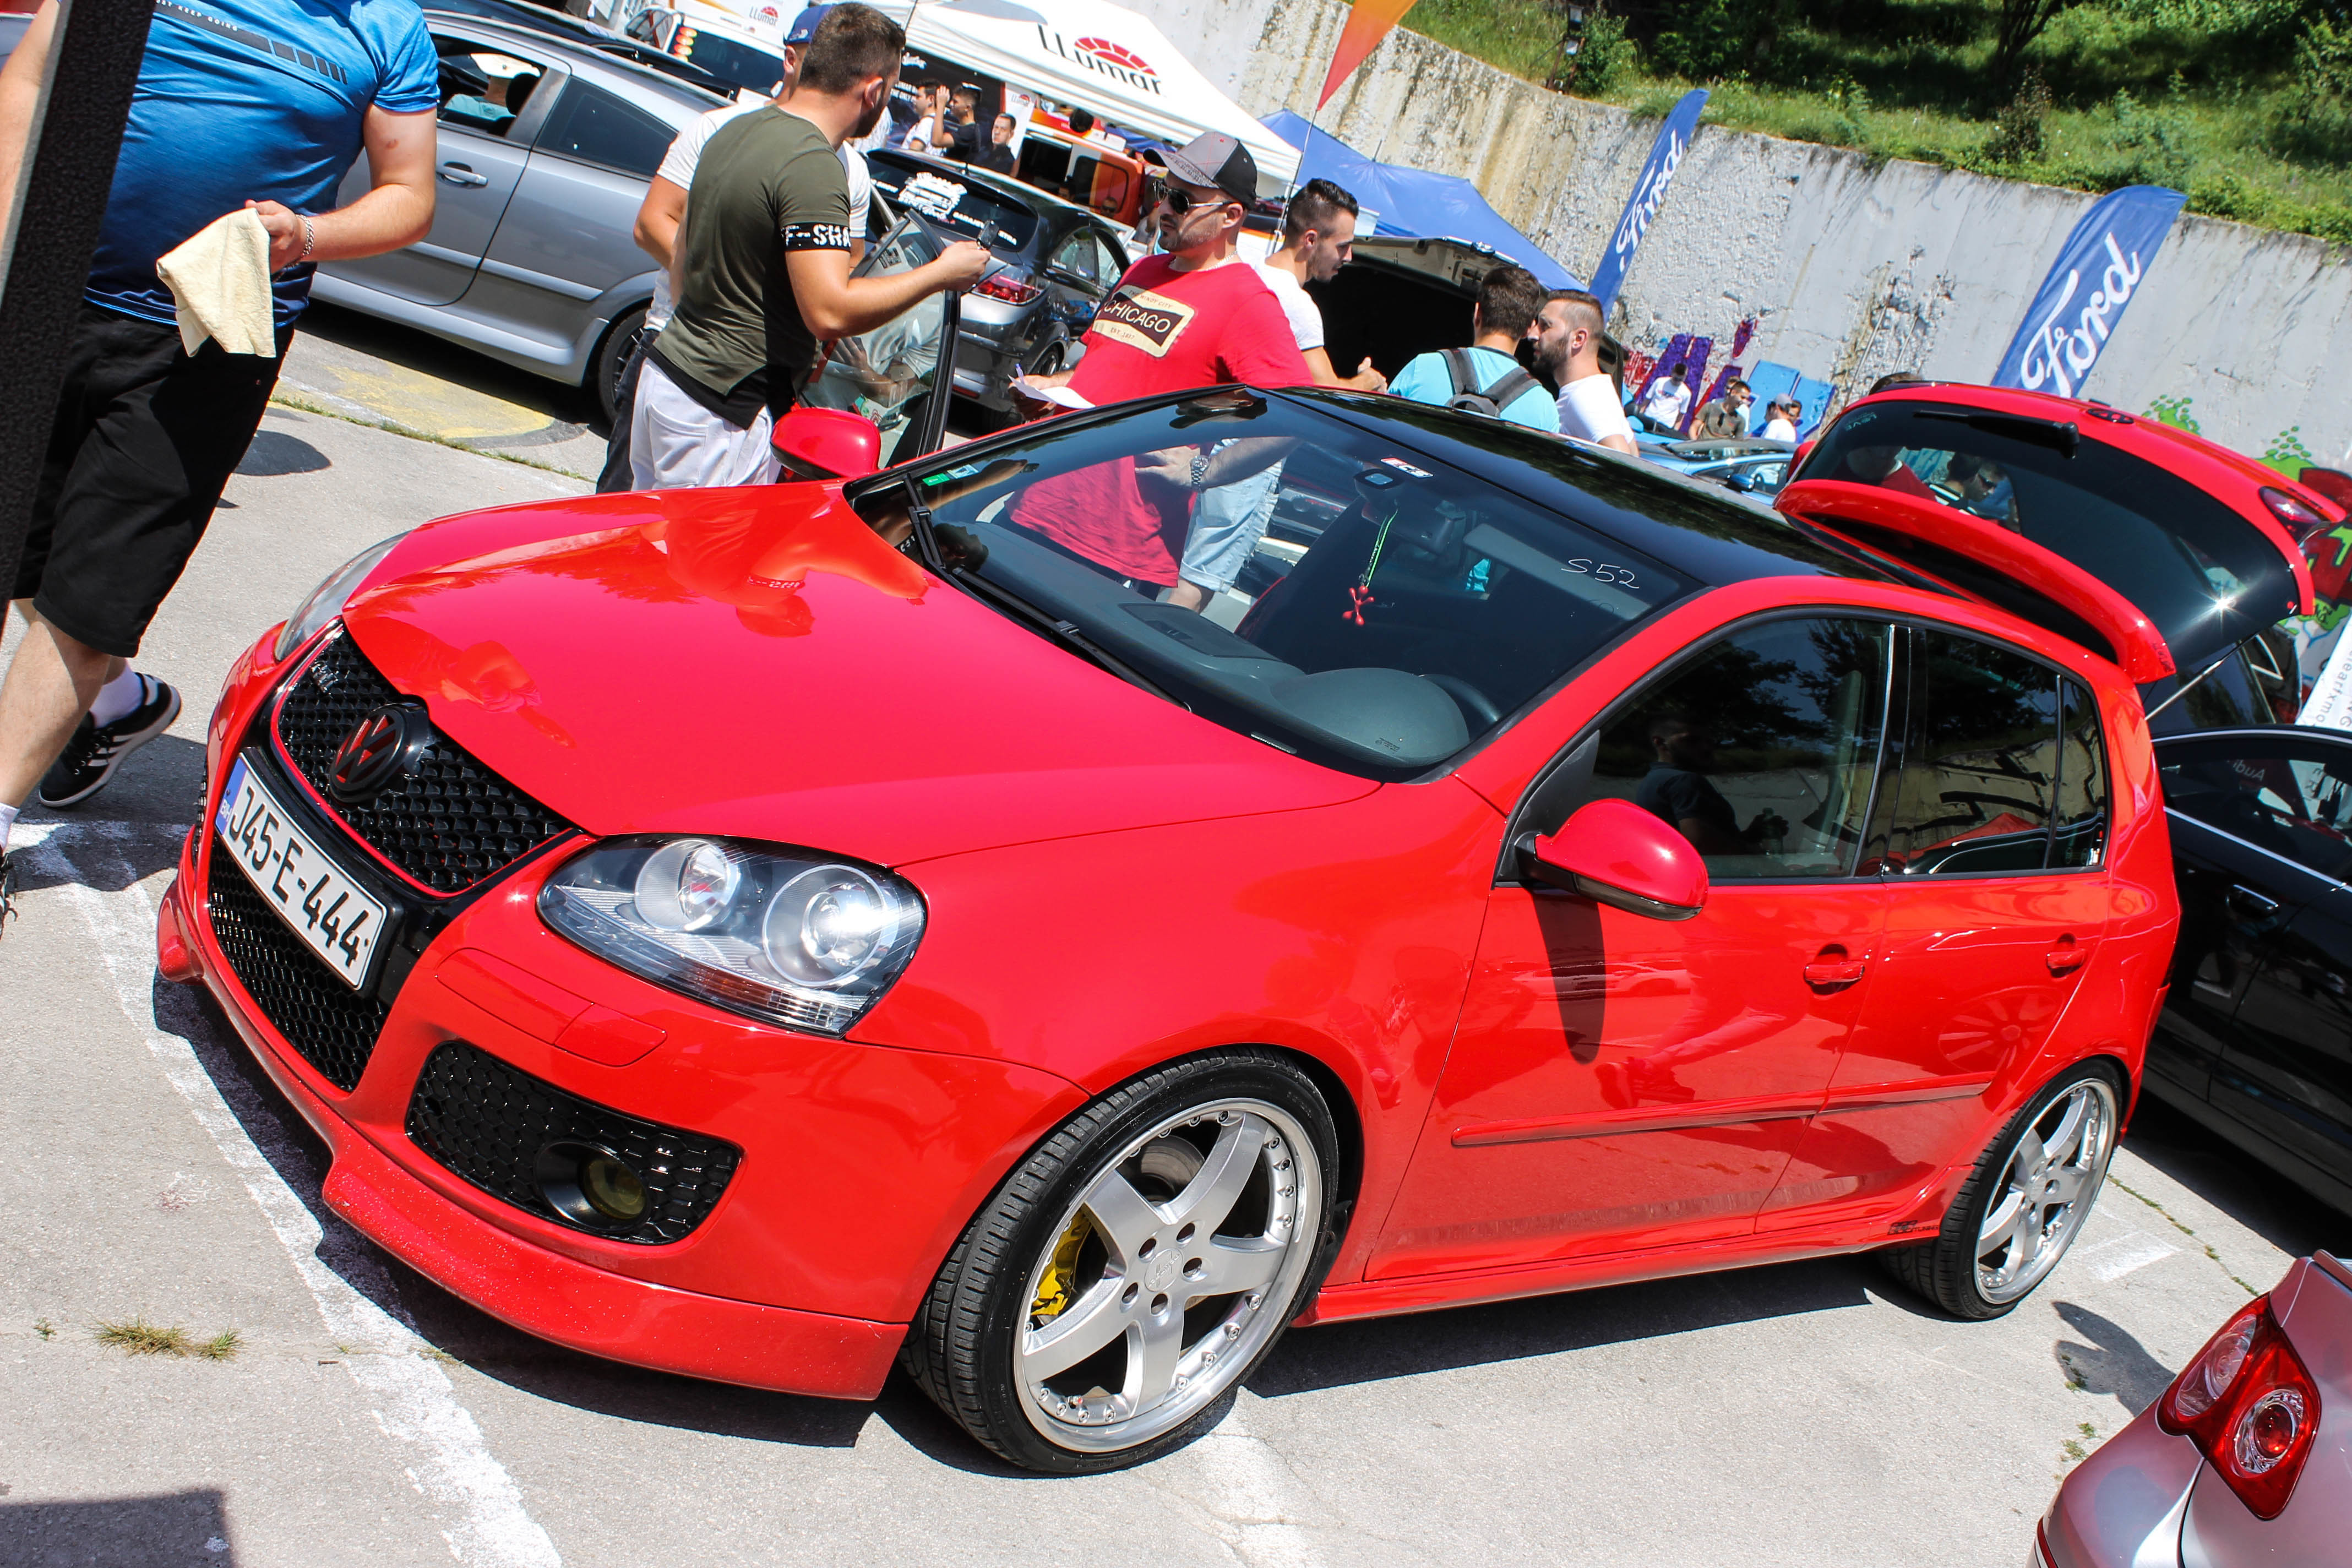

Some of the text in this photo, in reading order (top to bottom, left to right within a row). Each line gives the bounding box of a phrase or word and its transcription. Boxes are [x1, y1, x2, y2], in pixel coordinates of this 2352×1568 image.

[178, 5, 202, 17] KEEP
[208, 16, 238, 31] GOING
[749, 6, 778, 27] LLumar
[1038, 23, 1161, 95] LLumar
[1616, 128, 1683, 273] Ford
[952, 211, 986, 229] SARAJEV
[1104, 300, 1171, 333] CHICAGO
[1140, 295, 1158, 303] WINDY
[1158, 301, 1173, 309] CITY
[2021, 231, 2141, 399] Ford
[1561, 558, 1640, 589] S52
[2315, 643, 2352, 726] learfxmo
[230, 786, 369, 968] J45-E-444
